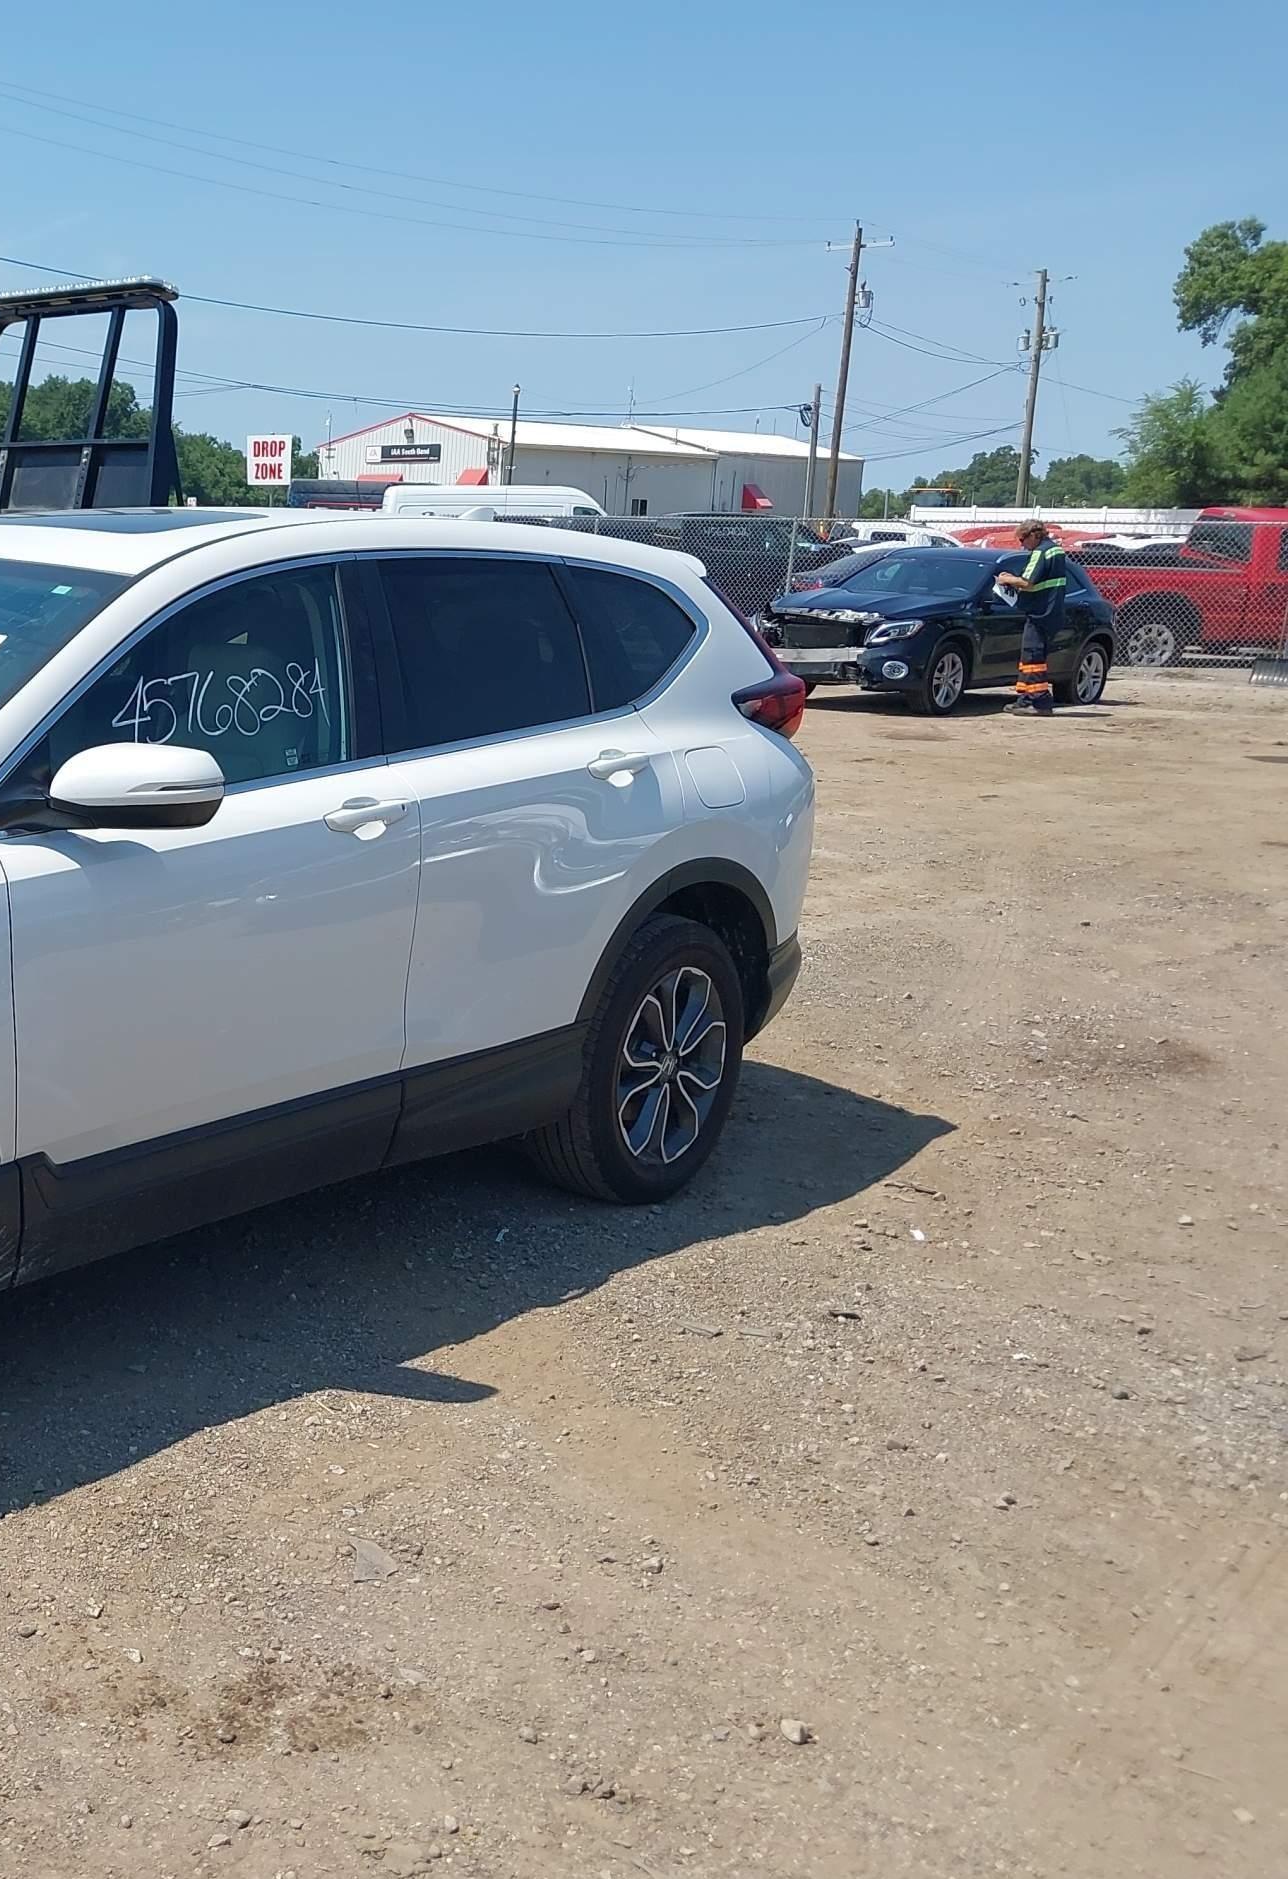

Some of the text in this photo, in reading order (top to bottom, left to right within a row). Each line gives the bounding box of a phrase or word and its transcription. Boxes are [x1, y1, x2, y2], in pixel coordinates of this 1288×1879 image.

[253, 440, 286, 458] DROP
[254, 463, 283, 480] ZONE
[112, 657, 331, 744] 45768284
